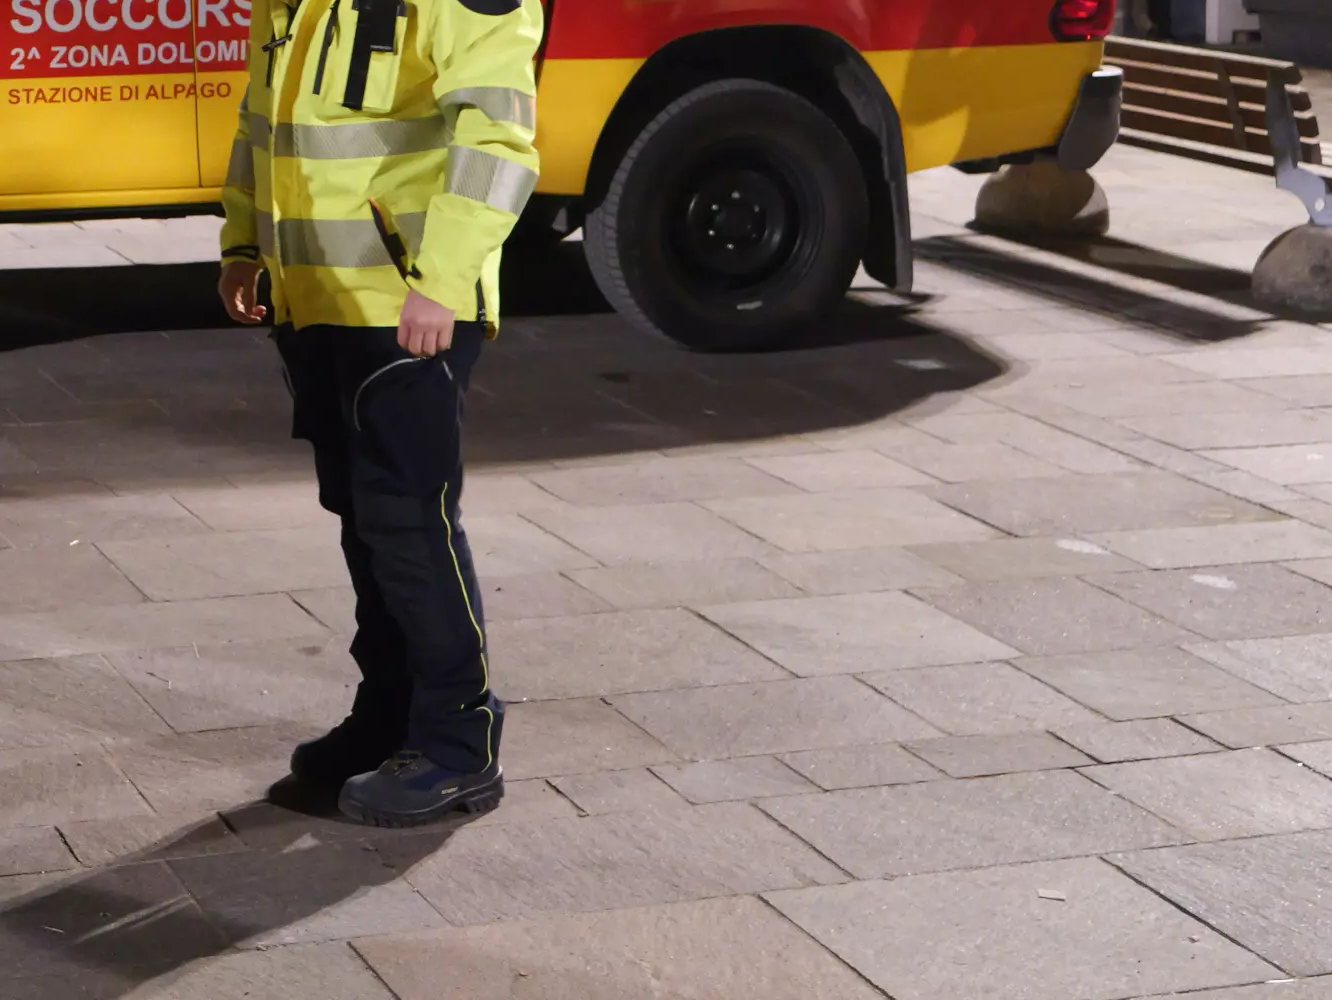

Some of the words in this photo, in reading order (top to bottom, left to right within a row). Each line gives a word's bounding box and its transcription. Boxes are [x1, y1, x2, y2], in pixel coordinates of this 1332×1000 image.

[49, 44, 130, 69] ZONA
[137, 39, 251, 66] DOLOMI
[8, 86, 113, 105] STAZIONE
[120, 84, 139, 101] DI
[145, 82, 231, 101] ALPAGO
